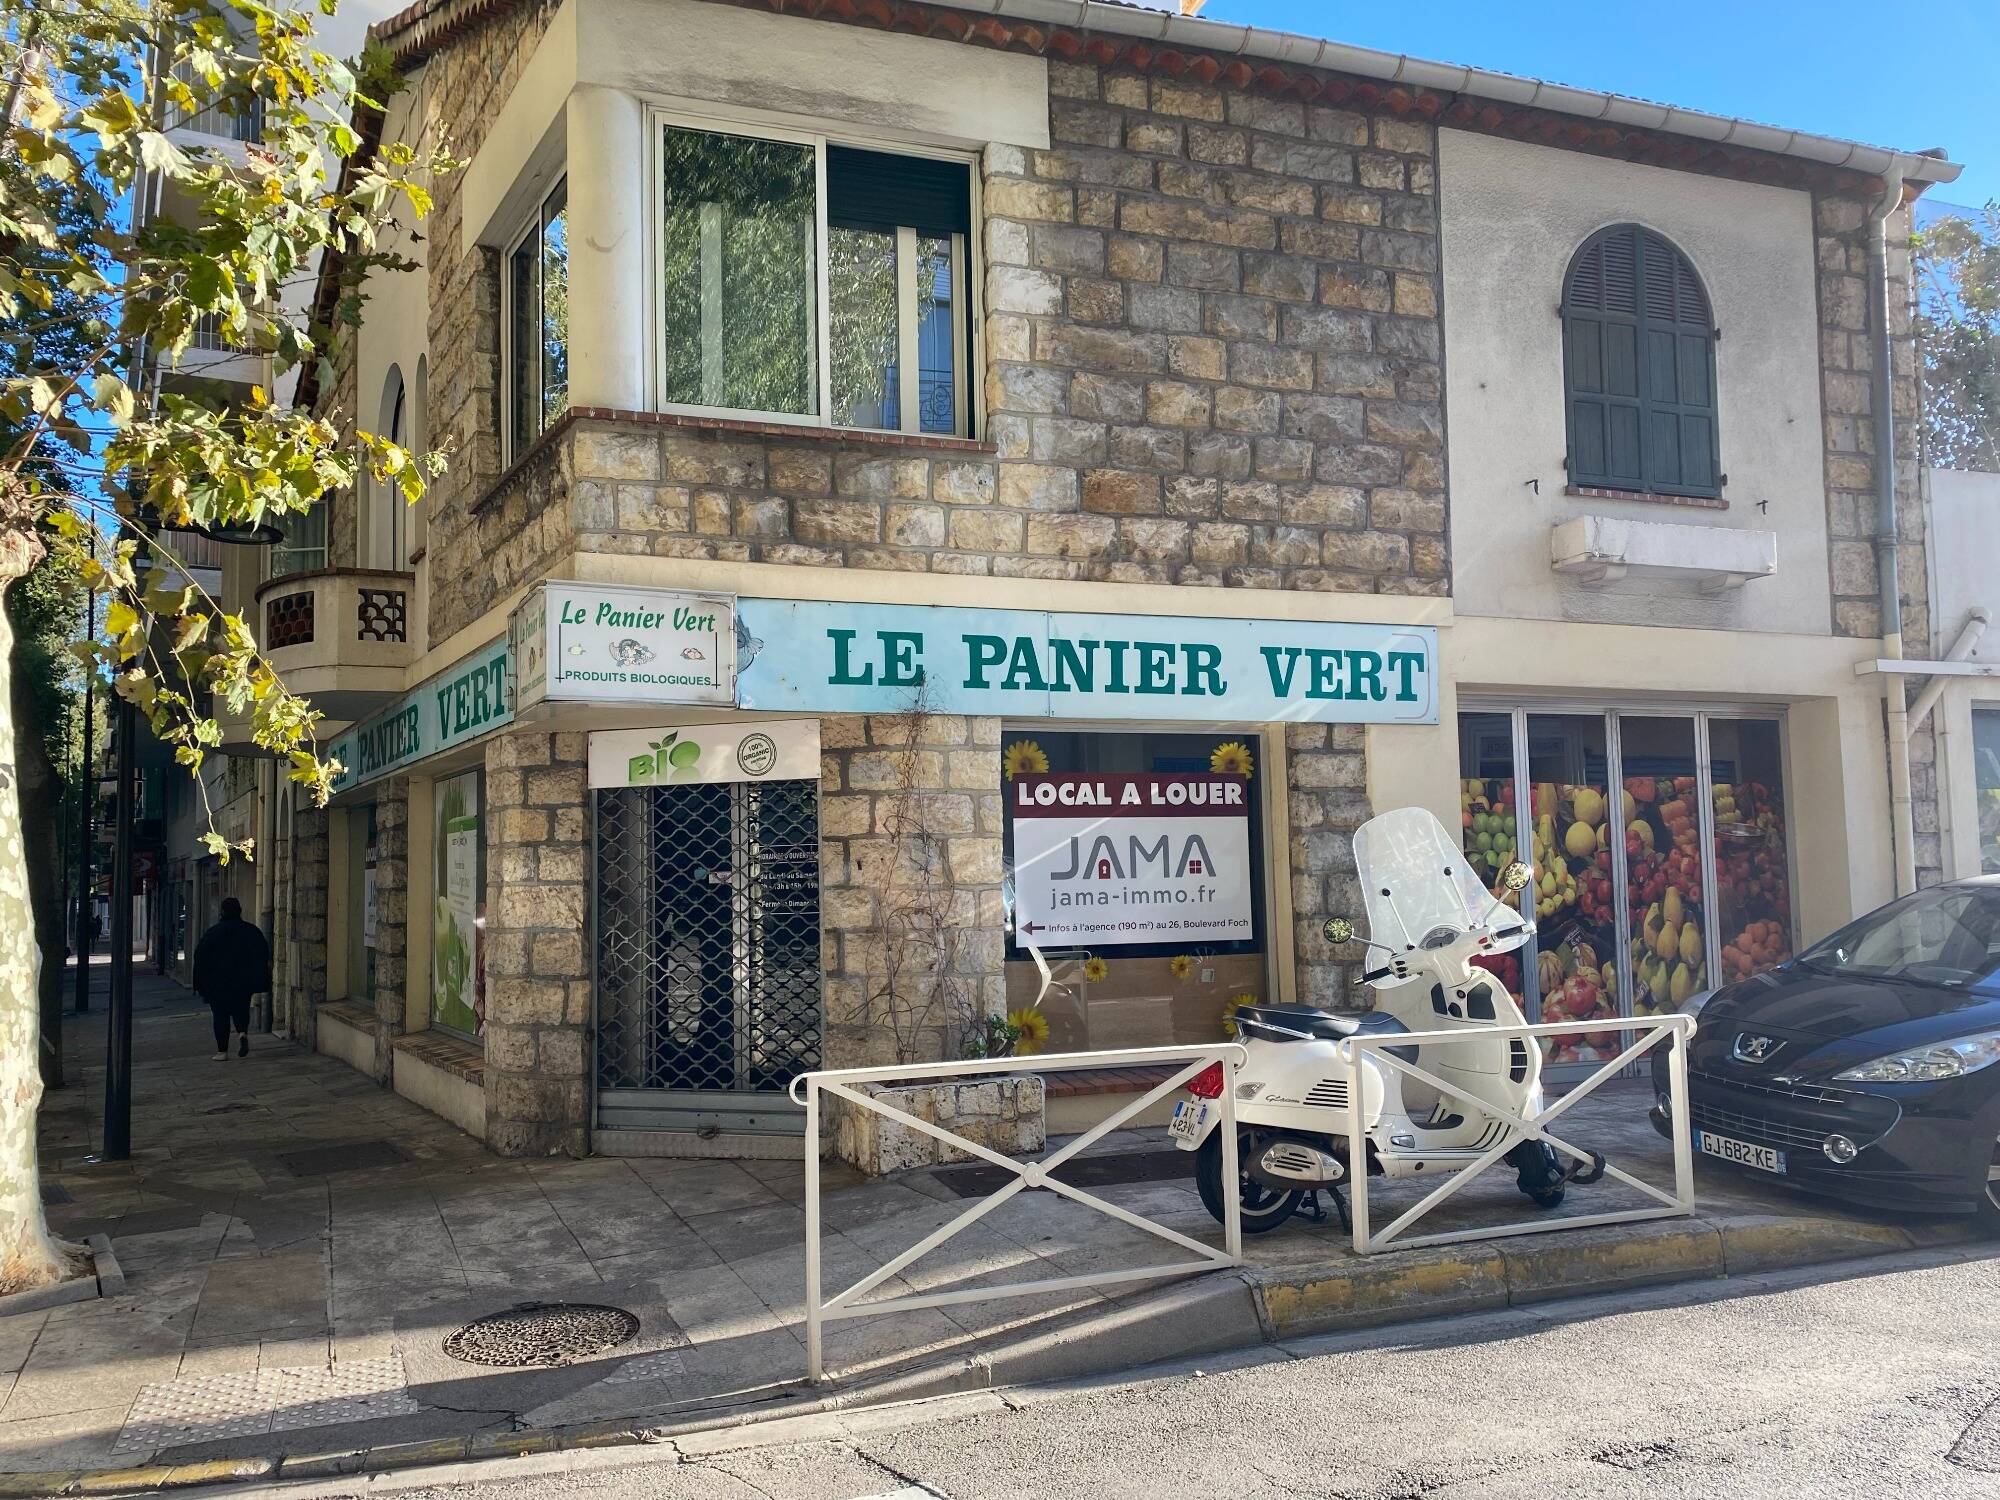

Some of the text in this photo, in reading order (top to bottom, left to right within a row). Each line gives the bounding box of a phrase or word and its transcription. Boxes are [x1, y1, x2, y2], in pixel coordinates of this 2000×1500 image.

[560, 600, 587, 624] Le
[595, 602, 665, 629] Panier
[673, 607, 716, 632] Vert
[565, 670, 711, 686] PRODUITS BIOLOGIQUES
[827, 629, 1425, 702] LE PANIER VERT
[358, 703, 420, 776] PANIER
[437, 653, 507, 740] VERT
[1018, 782, 1244, 806] LOCAL A LOUER
[1050, 834, 1217, 881] JAMA
[1050, 885, 1216, 910] jama-immo.fr
[1048, 924, 1070, 932] Infos
[1072, 923, 1078, 931] à
[1080, 922, 1116, 934] l'agence
[1118, 921, 1136, 932] (190
[1169, 920, 1182, 930] 26,
[1183, 919, 1226, 929] Boulevard
[1228, 918, 1249, 927] Foch
[1703, 1134, 1775, 1169] GJ-682-KE
